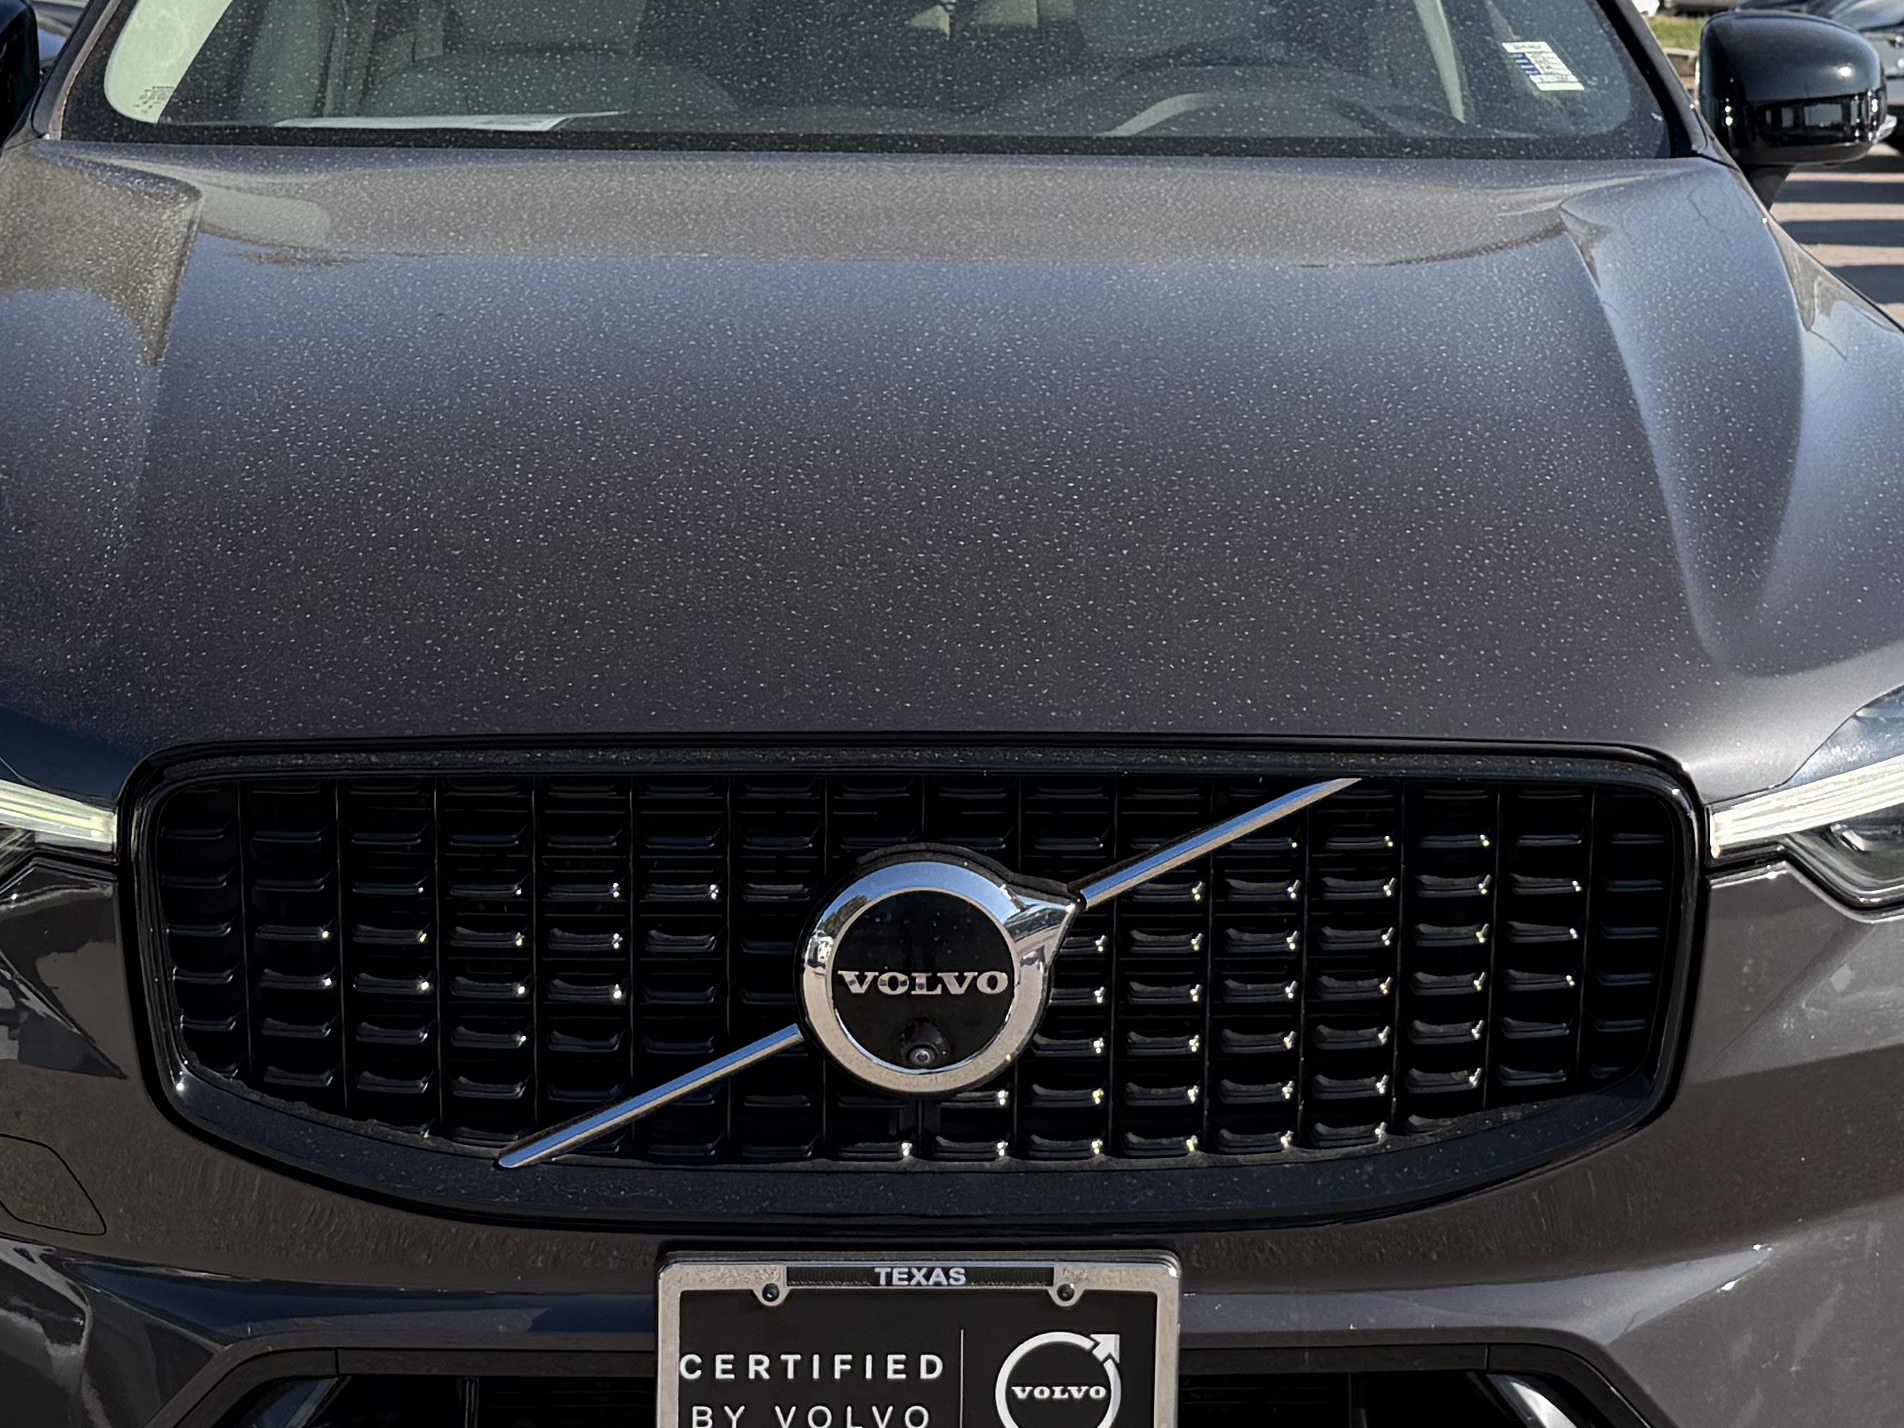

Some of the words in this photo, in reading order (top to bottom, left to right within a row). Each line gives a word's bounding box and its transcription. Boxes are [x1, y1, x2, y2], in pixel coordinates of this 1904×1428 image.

[838, 971, 1008, 995] VOLVO
[874, 1267, 966, 1286] TEXAS
[680, 1354, 943, 1380] CERTIFIED
[1011, 1385, 1107, 1400] VOLVO
